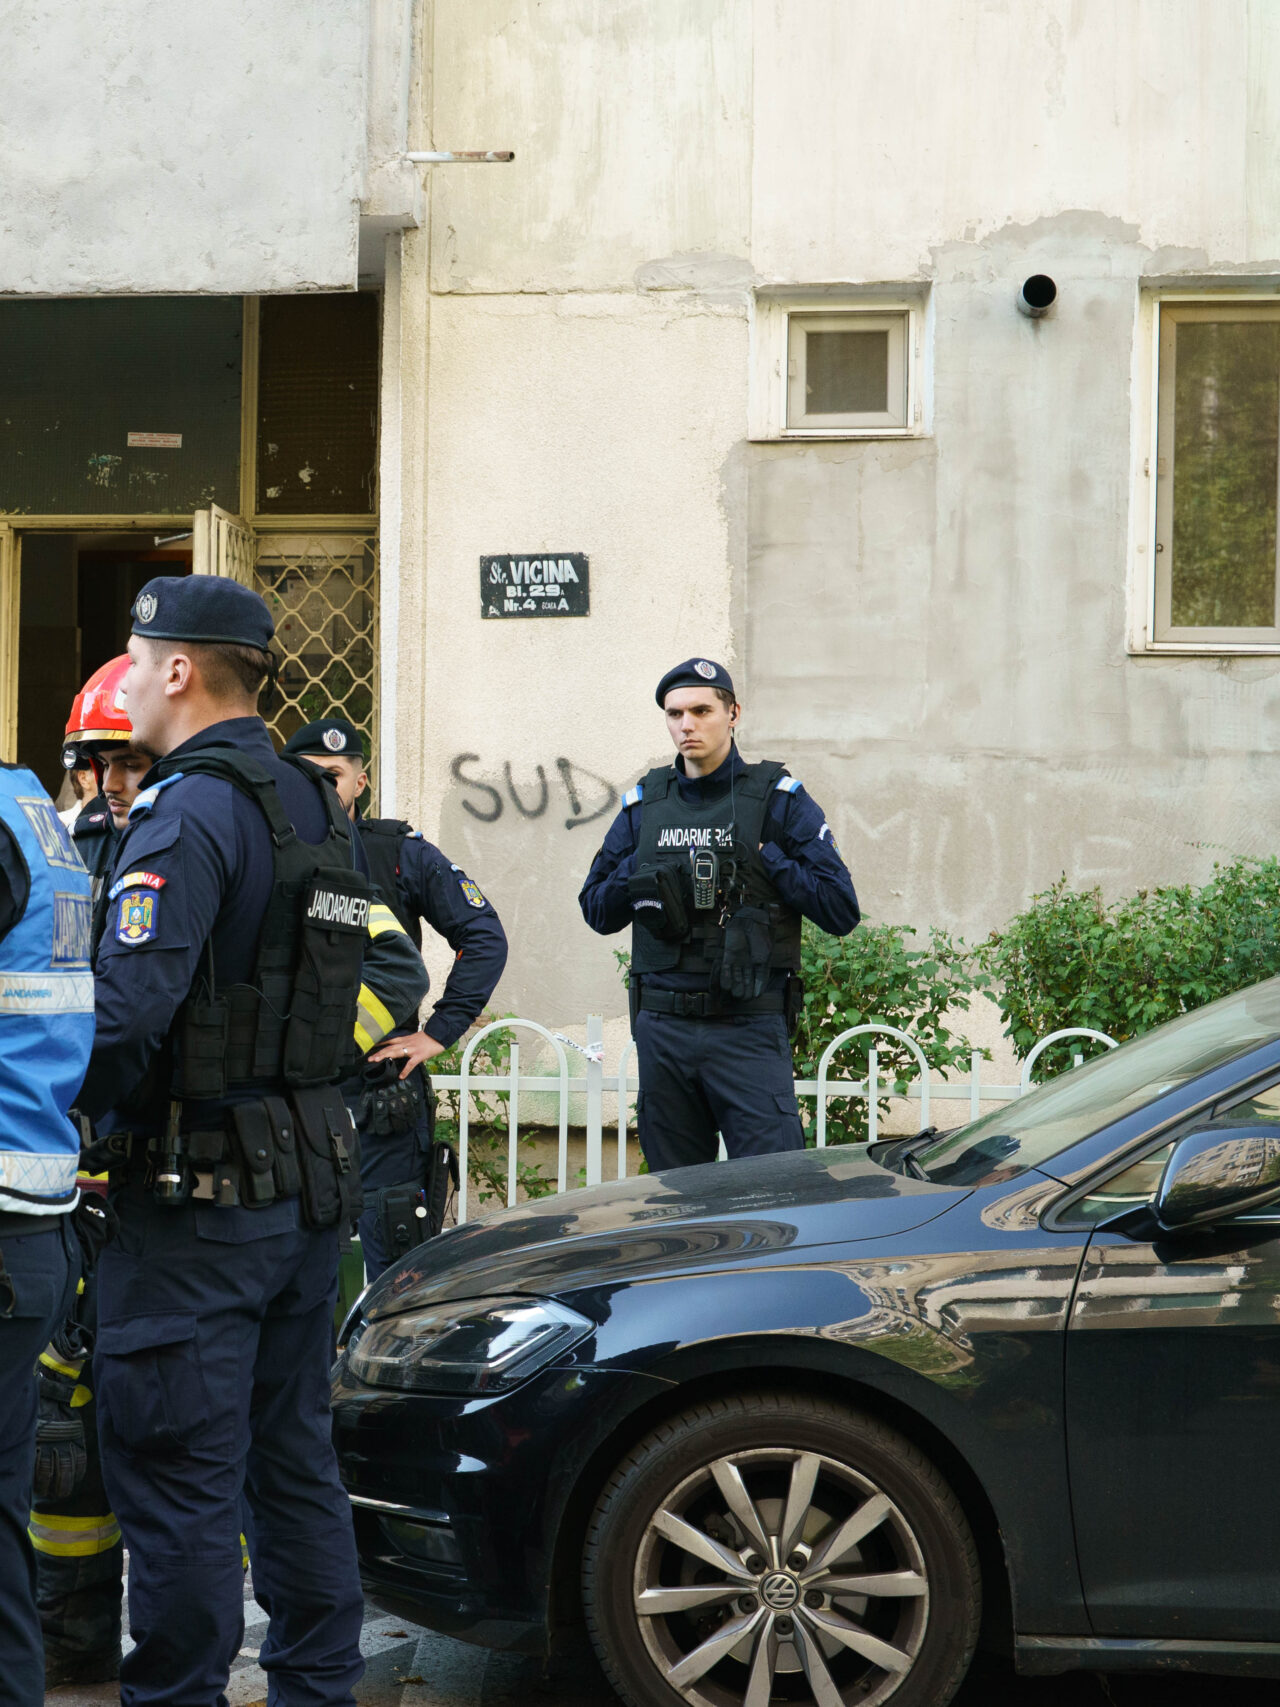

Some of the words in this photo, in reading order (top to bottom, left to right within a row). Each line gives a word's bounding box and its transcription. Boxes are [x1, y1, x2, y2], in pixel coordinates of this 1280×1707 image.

[489, 561, 508, 584] Str.
[510, 559, 579, 584] VICINA
[450, 751, 618, 830] SUD
